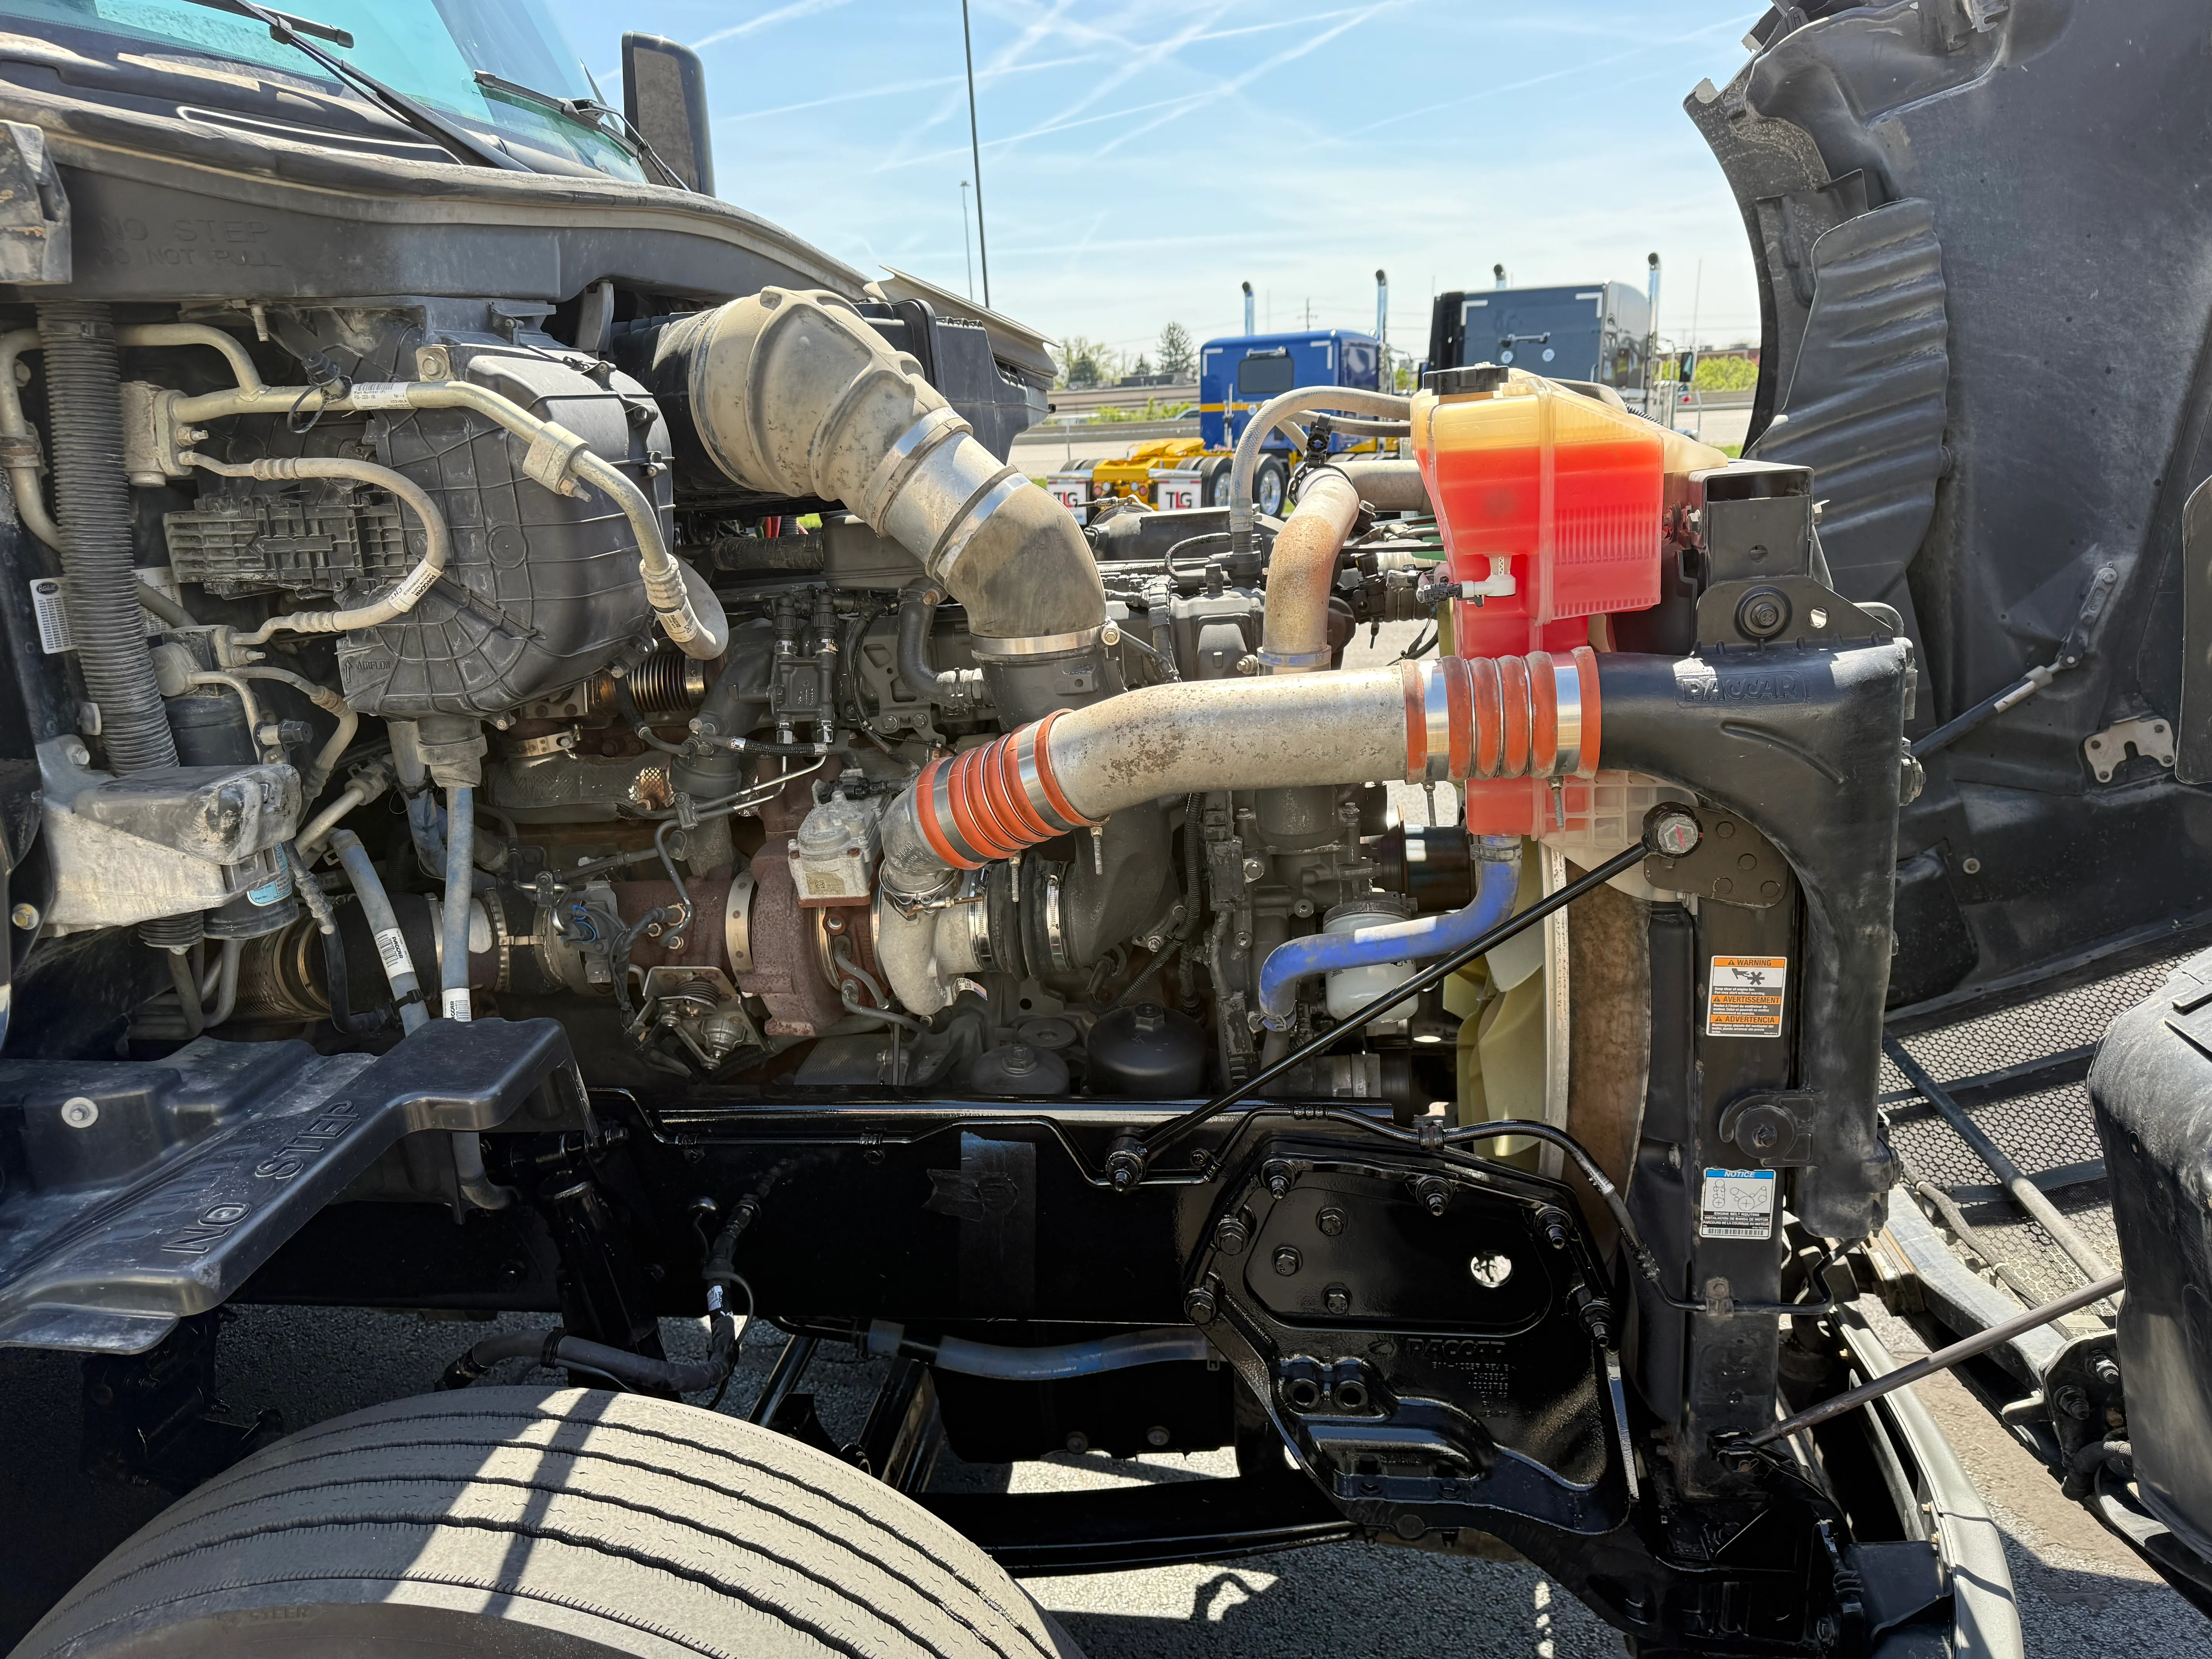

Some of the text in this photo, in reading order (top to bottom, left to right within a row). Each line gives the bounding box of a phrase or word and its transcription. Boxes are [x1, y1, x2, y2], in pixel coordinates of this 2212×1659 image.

[100, 217, 269, 243] NO STEP
[98, 247, 284, 267] DO NOT PULL
[1053, 491, 1079, 508] TLG
[1165, 491, 1193, 509] TLG
[357, 660, 390, 671] AIRFLOW
[1682, 677, 1798, 702] PACCAR
[392, 936, 404, 959] PACCAR
[1724, 1015, 1775, 1024] ADVERTENCIA
[161, 1100, 361, 1254] NO STEP
[1407, 1338, 1507, 1359] PACCAR
[249, 1606, 308, 1623] STEER
